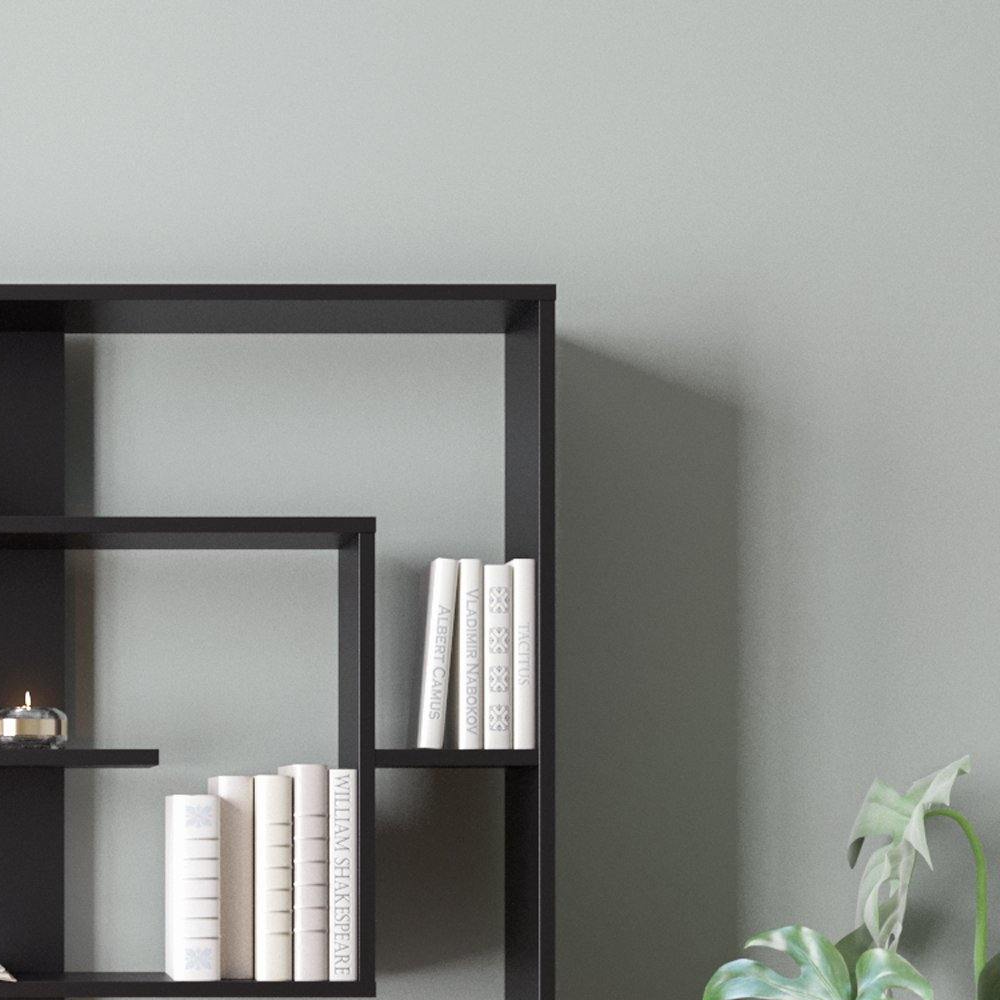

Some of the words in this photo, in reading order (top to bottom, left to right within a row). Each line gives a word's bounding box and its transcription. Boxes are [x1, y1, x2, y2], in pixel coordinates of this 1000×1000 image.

[433, 604, 450, 663] ALBERT
[465, 588, 480, 658] VLADIMIR
[517, 623, 530, 687] TACITUS
[428, 666, 446, 721] CAMUS
[465, 660, 480, 735] NABOKOV
[333, 774, 350, 852] WILLIAM
[333, 856, 350, 977] SHAKESPEARE
